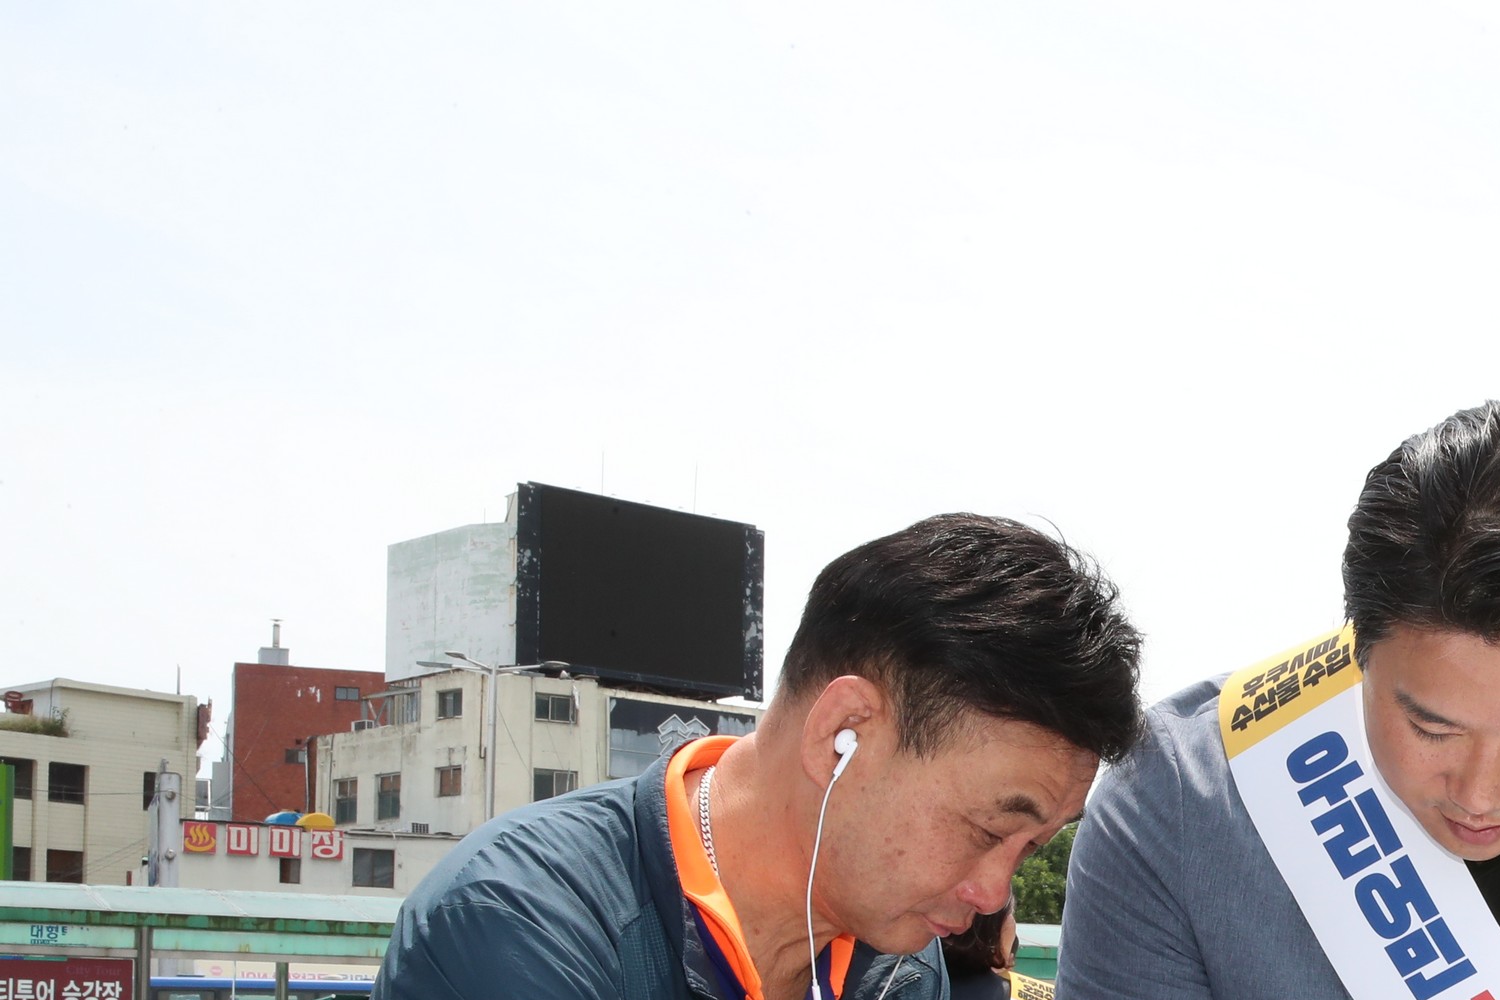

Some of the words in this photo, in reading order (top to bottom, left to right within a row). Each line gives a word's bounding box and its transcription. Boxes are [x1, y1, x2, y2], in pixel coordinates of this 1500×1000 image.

[1231, 672, 1302, 732] 수산물
[1303, 643, 1351, 687] 수입
[1242, 634, 1340, 698] 후쿠시마
[229, 826, 344, 858] 미미장
